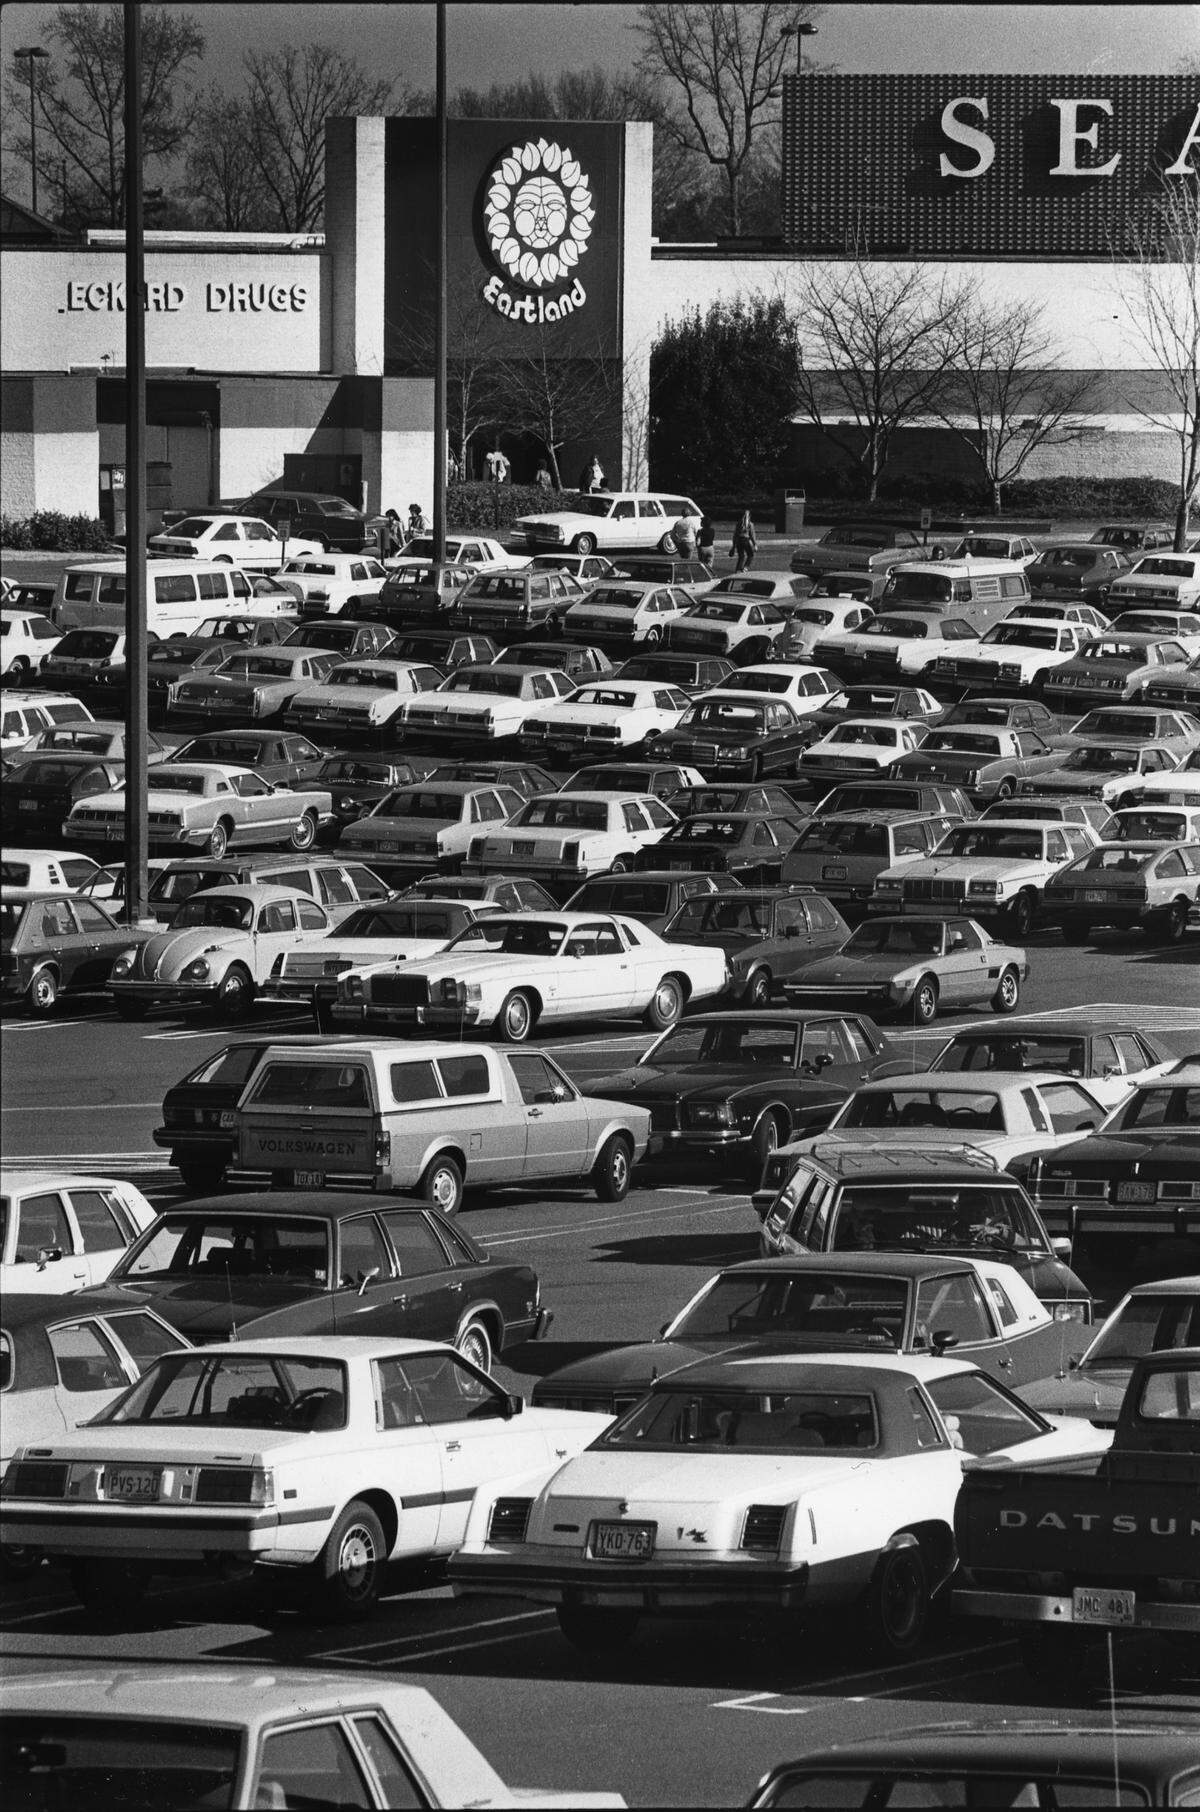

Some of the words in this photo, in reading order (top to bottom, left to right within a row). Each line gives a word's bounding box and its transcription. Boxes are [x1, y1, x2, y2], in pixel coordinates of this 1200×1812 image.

[67, 281, 186, 312] ECKRD
[206, 282, 308, 312] DRUGS
[483, 275, 587, 323] Eastland
[258, 1139, 356, 1155] VOLKSWAGEN
